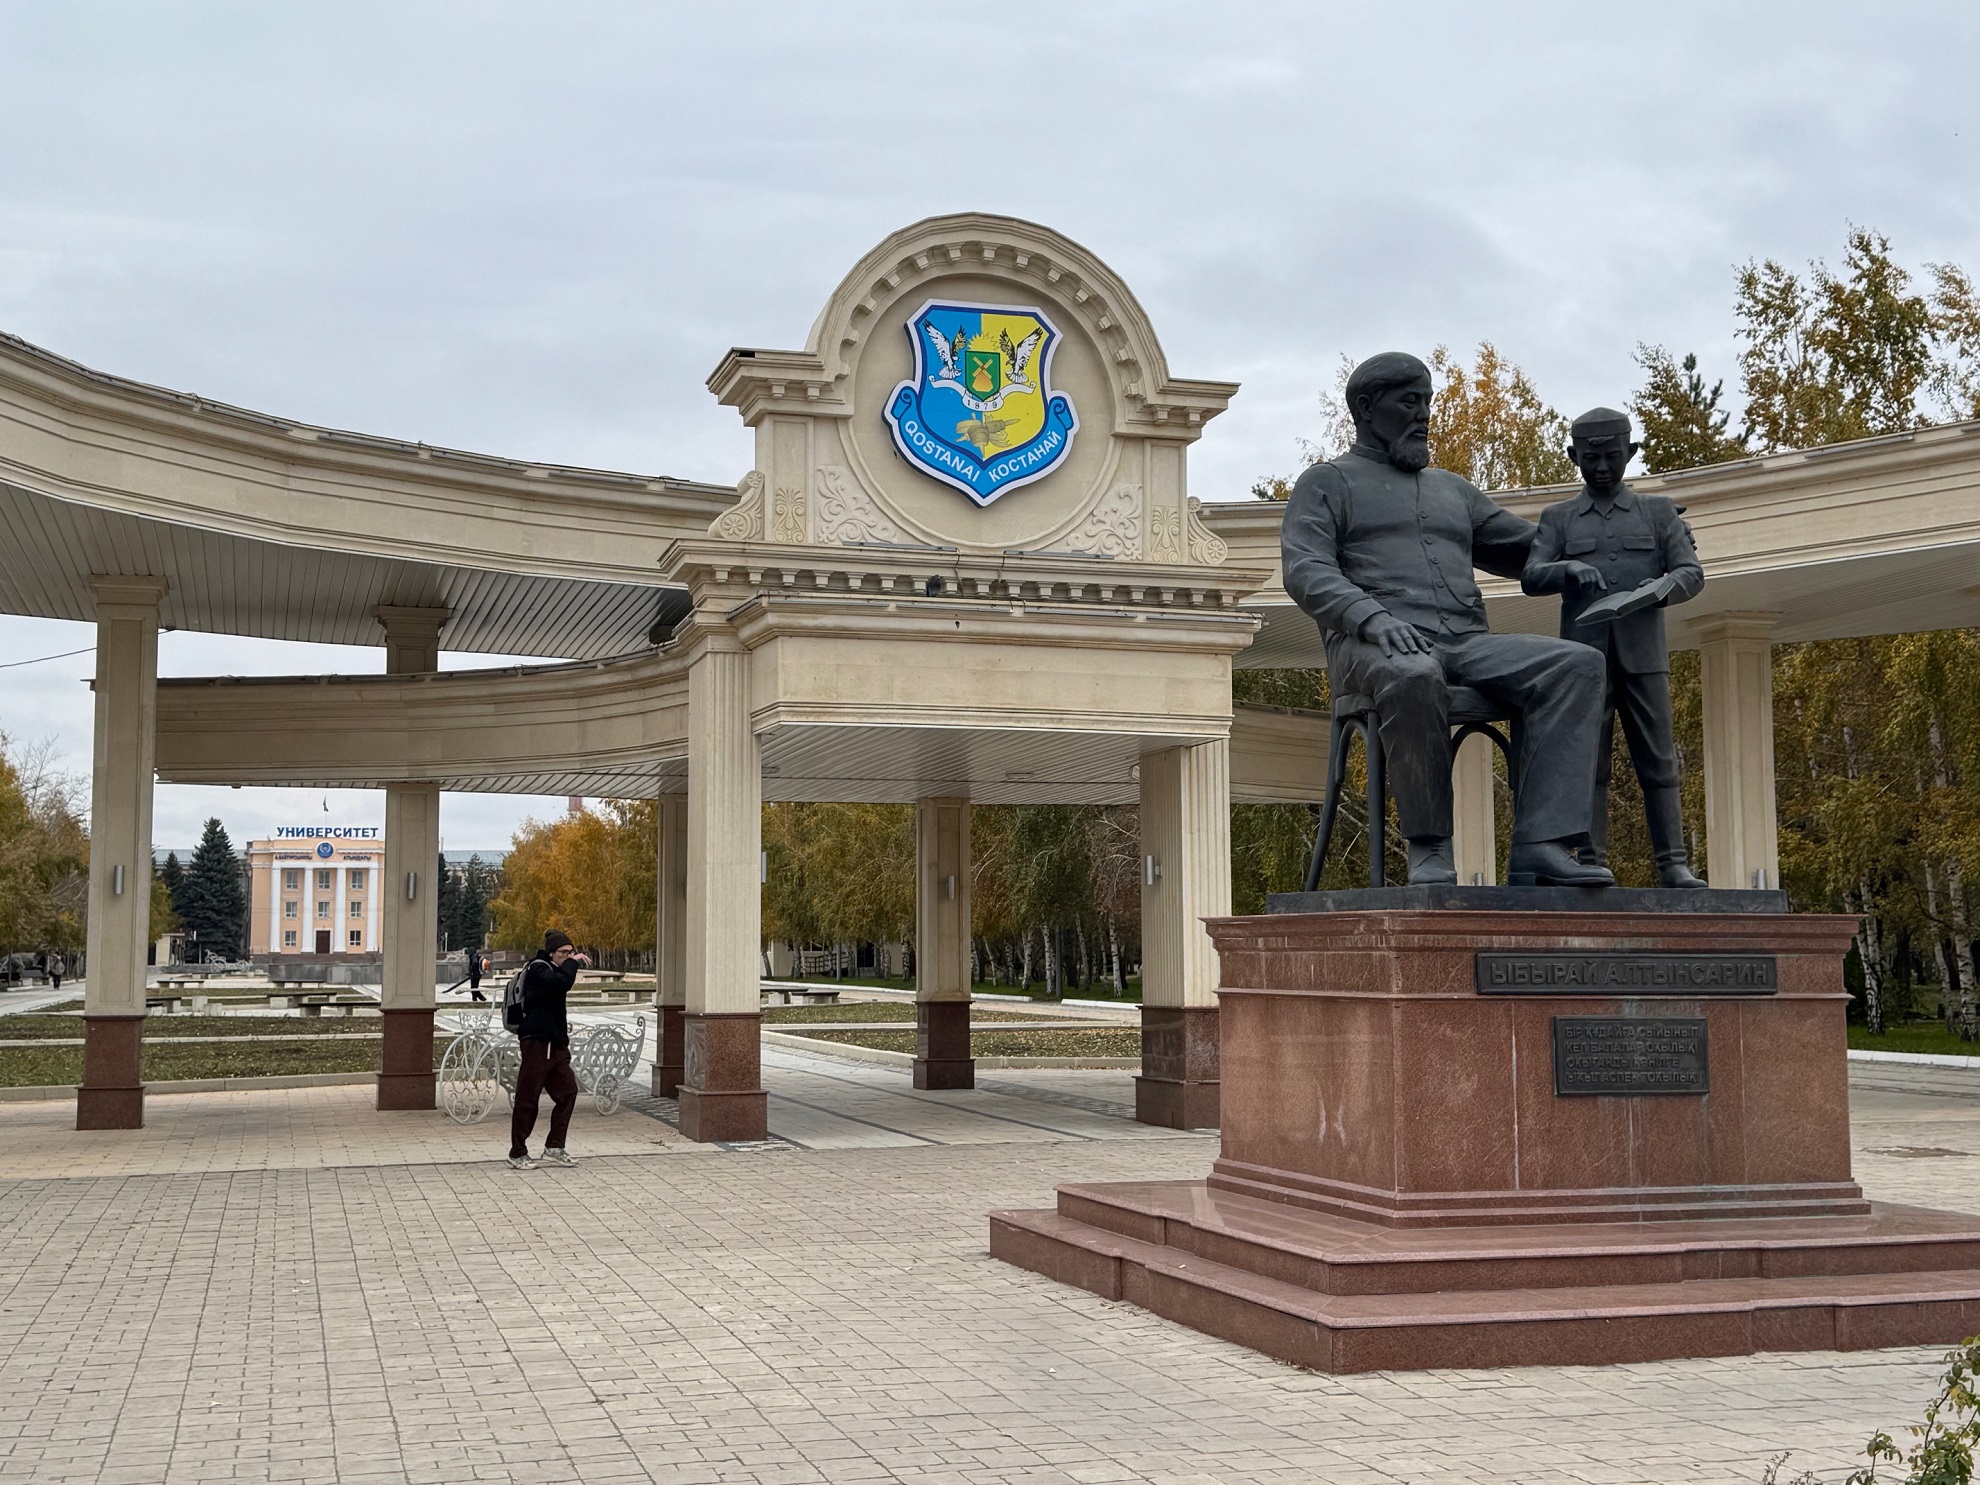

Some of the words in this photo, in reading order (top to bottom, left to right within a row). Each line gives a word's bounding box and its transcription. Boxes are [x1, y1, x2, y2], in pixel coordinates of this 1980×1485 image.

[967, 400, 998, 410] 1879
[904, 420, 981, 483] QOSTANAI
[988, 430, 1062, 483] КОСТАНАЙ
[277, 827, 378, 838] УНИВЕРСИТЕТ
[1490, 960, 1598, 985] ЫБЫРАЙ
[1603, 963, 1769, 986] АЛТЫНСАРИН
